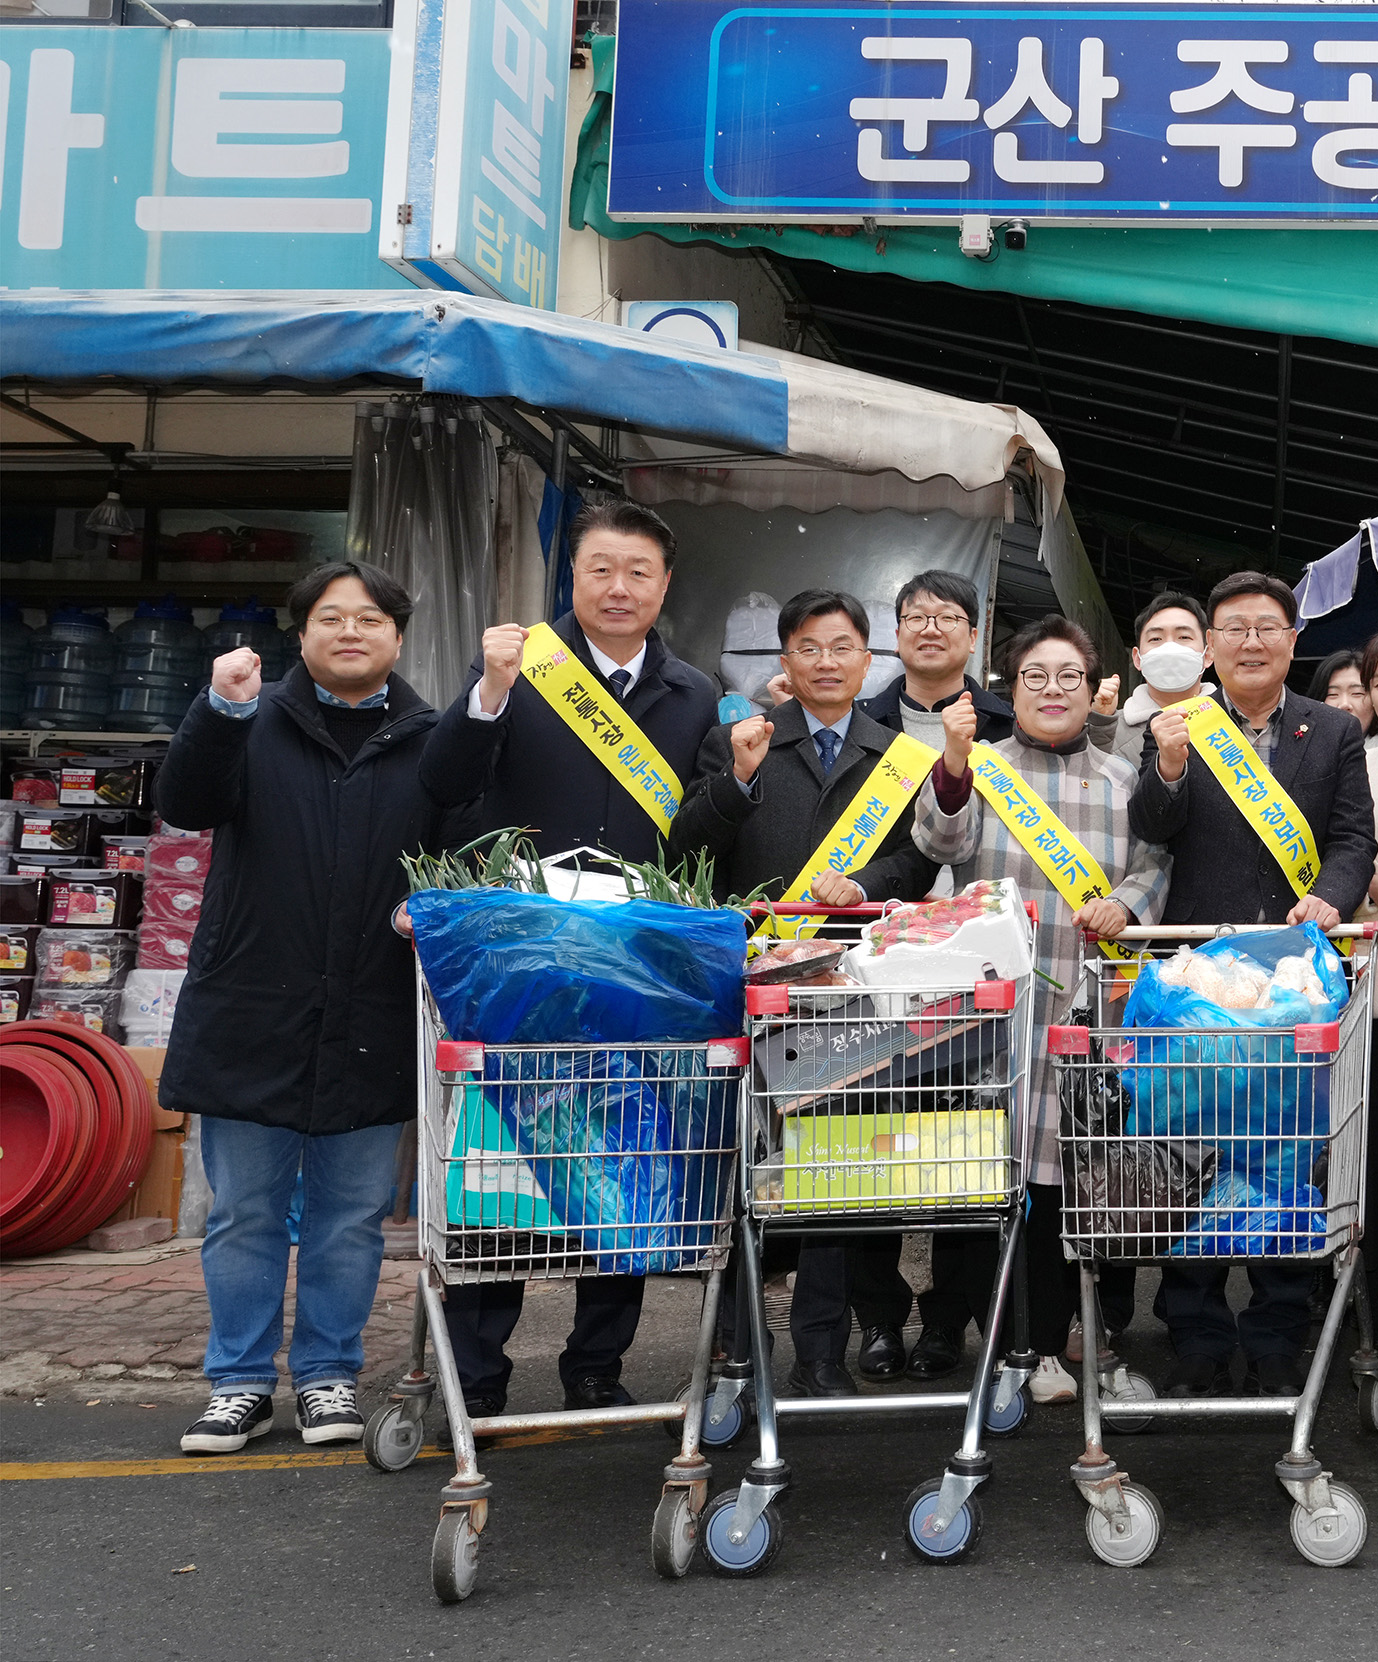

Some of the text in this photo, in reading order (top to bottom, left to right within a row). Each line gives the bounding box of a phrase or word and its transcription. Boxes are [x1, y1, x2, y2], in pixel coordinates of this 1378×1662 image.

[849, 36, 1119, 184] 군산
[472, 193, 547, 311] 담배
[562, 681, 625, 747] 전통시장
[827, 795, 891, 874] 전통시장
[973, 759, 1091, 886] 전통시장 장보기
[1205, 727, 1269, 803] 전통시장
[1259, 801, 1308, 862] 장보기
[54, 886, 70, 895] 7.2L
